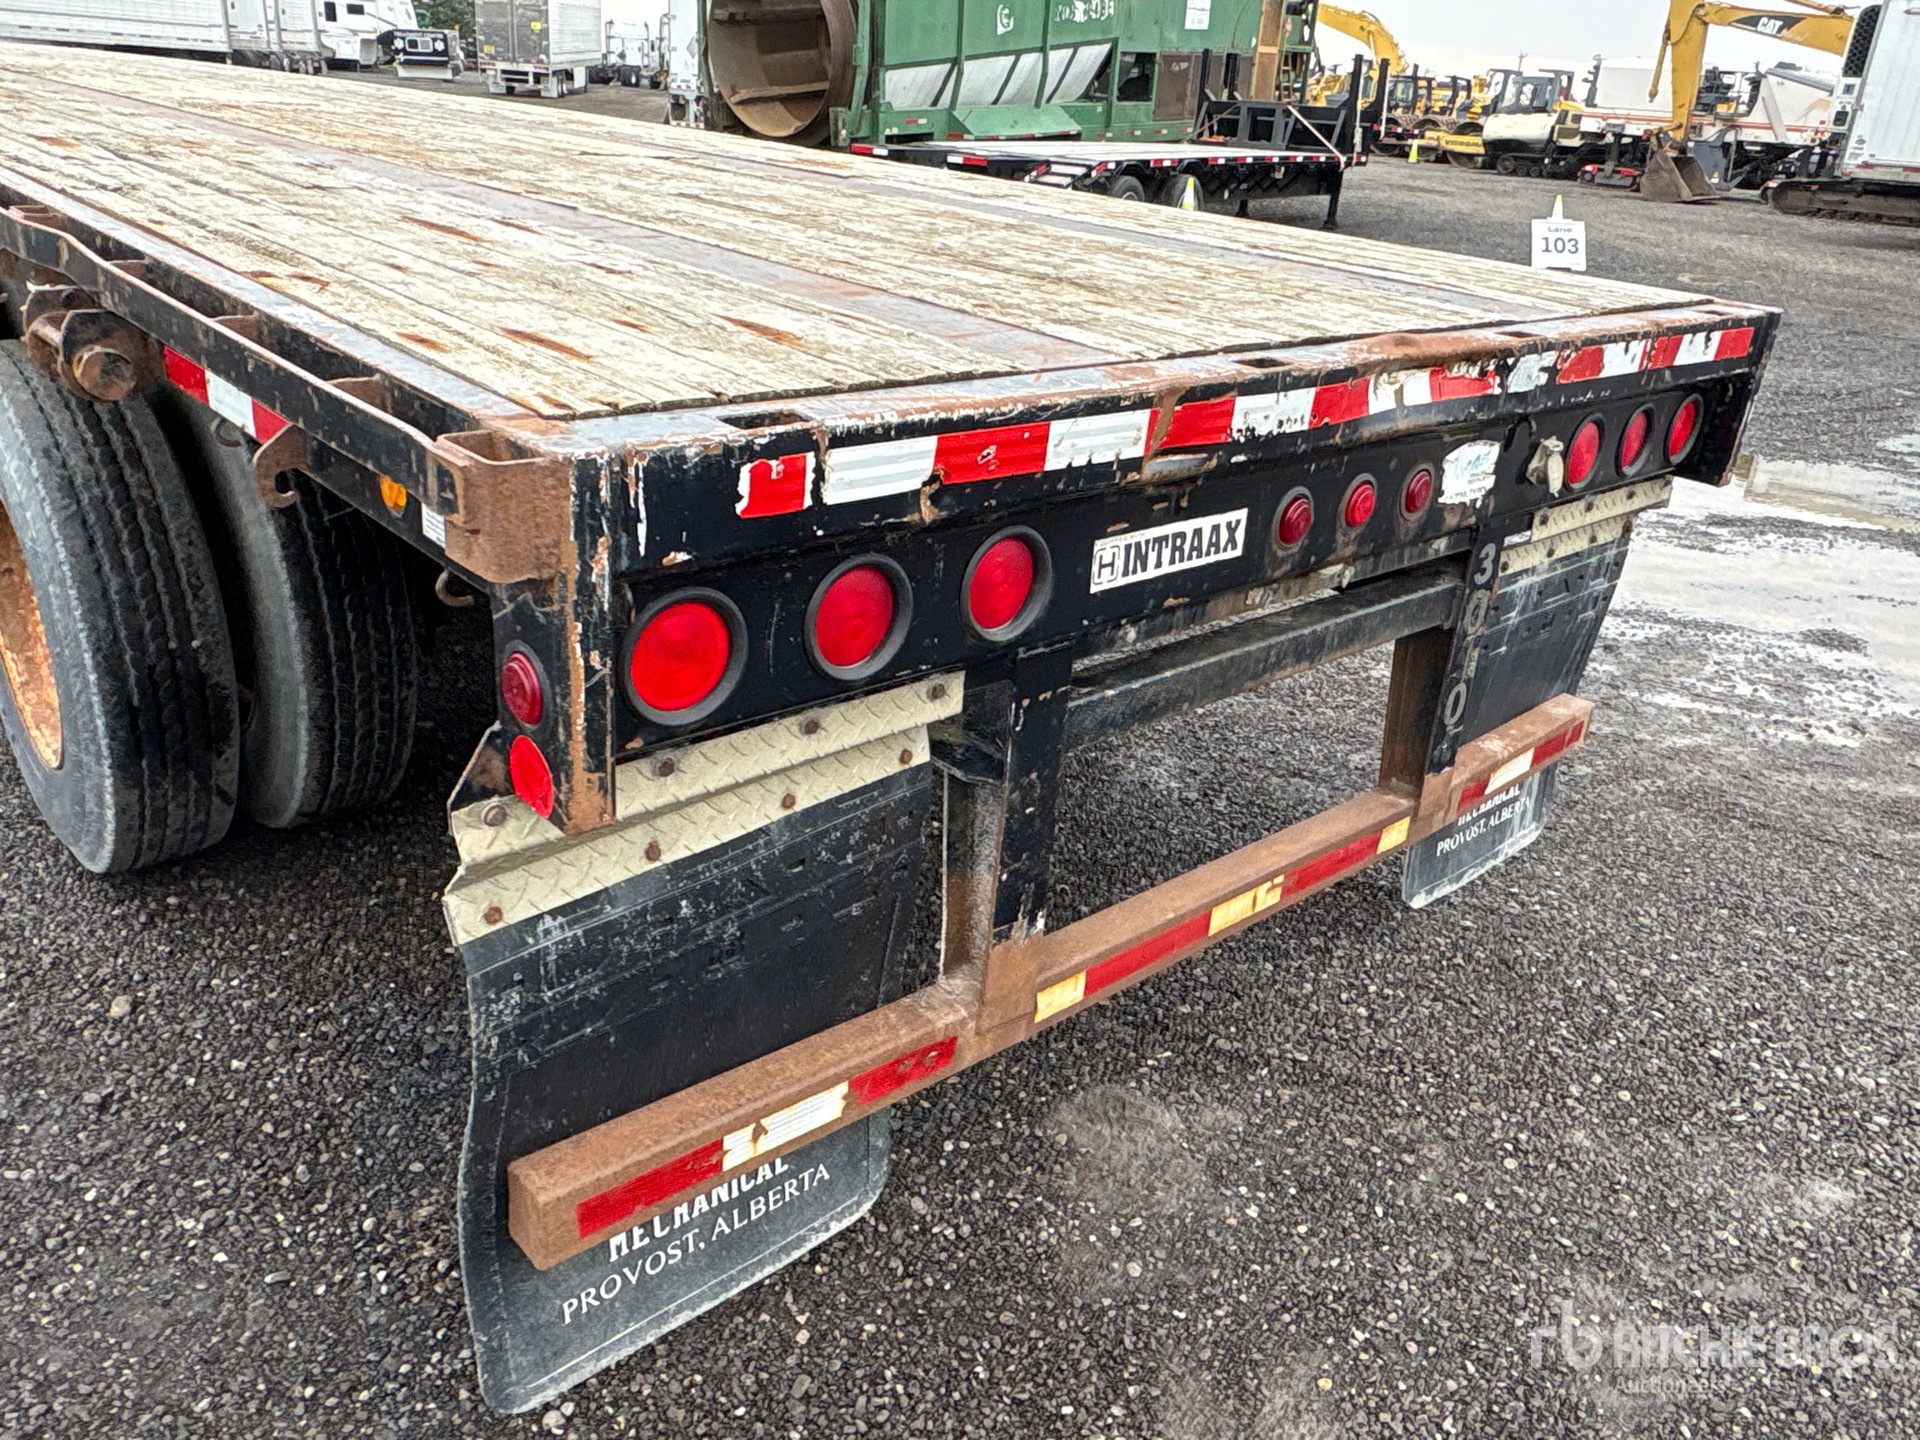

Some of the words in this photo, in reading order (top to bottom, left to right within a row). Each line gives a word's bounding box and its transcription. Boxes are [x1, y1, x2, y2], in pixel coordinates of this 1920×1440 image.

[1756, 16, 1784, 35] CAT
[1541, 236, 1579, 254] 103
[562, 1228, 706, 1325] PROVOST,
[711, 1163, 831, 1241] ALBERTA
